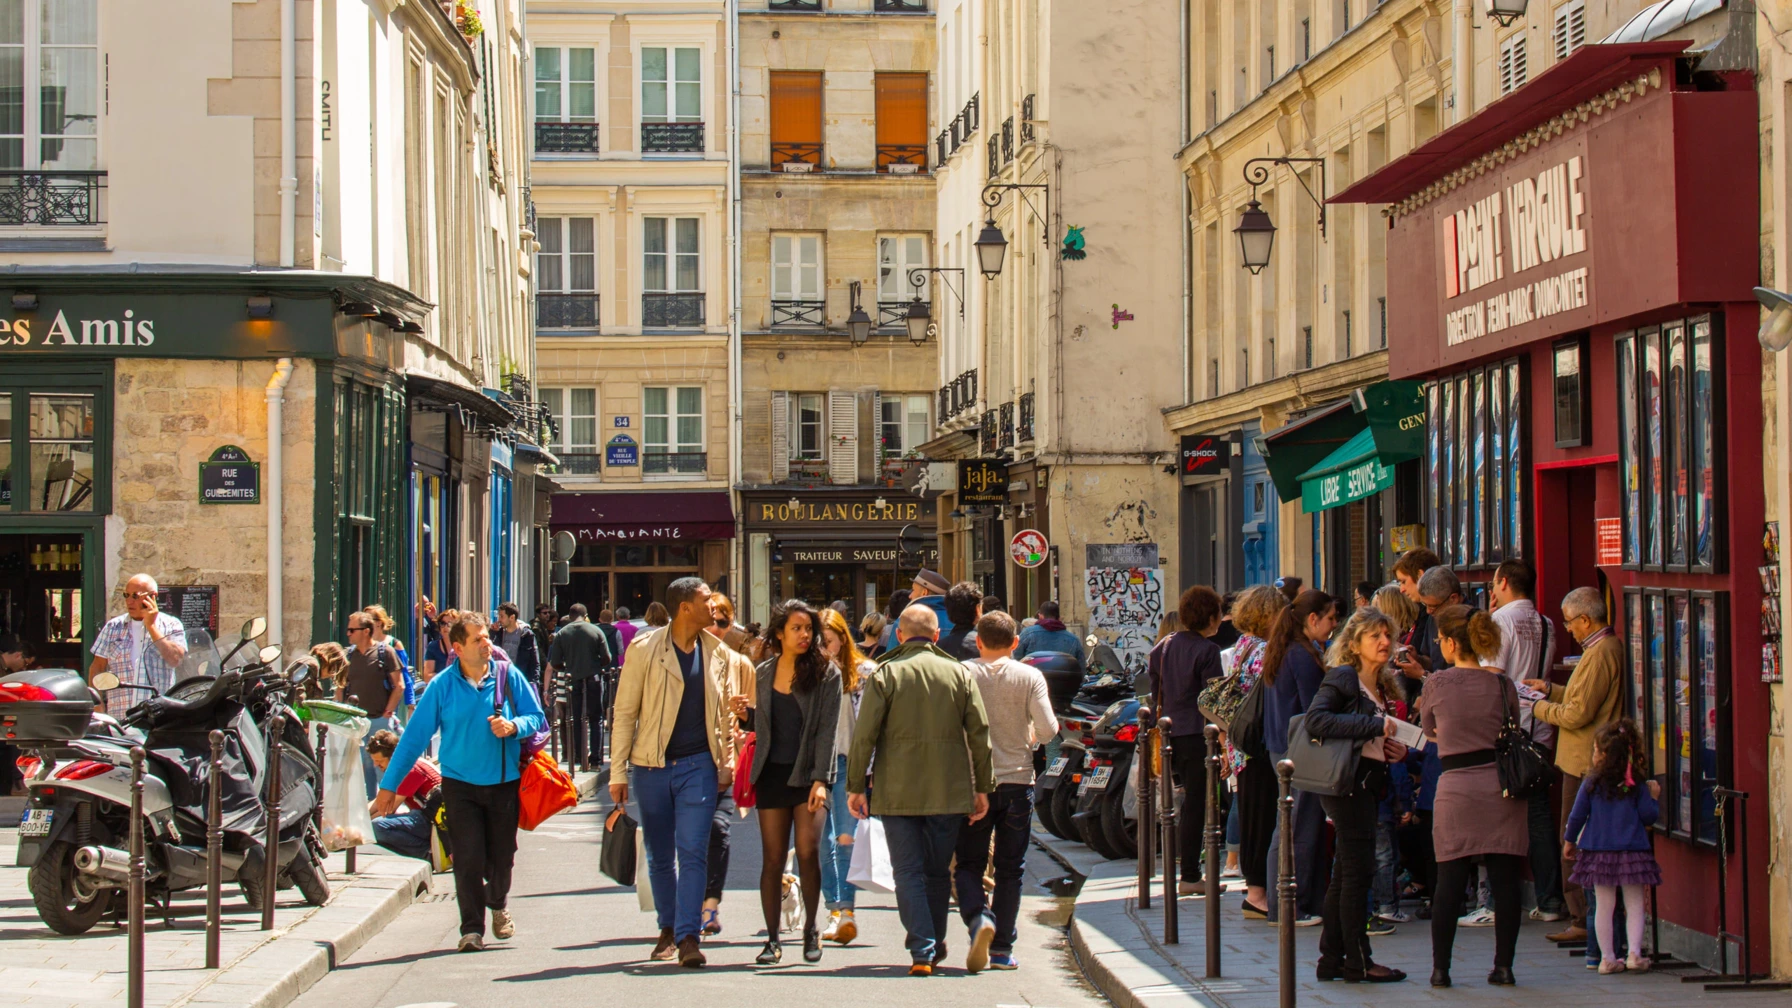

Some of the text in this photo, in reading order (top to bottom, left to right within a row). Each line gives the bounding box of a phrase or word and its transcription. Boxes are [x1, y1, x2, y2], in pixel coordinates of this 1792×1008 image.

[41, 308, 155, 347] Amis
[616, 417, 628, 427] 34
[1183, 449, 1217, 457] G-SHOCK
[221, 468, 238, 478] RUE
[1320, 475, 1340, 506] LIBRE
[1347, 461, 1376, 498] SERVICE
[761, 503, 918, 521] BOULANGERIE
[794, 552, 842, 561] TRAITEUR
[21, 822, 50, 832] 600-YE
